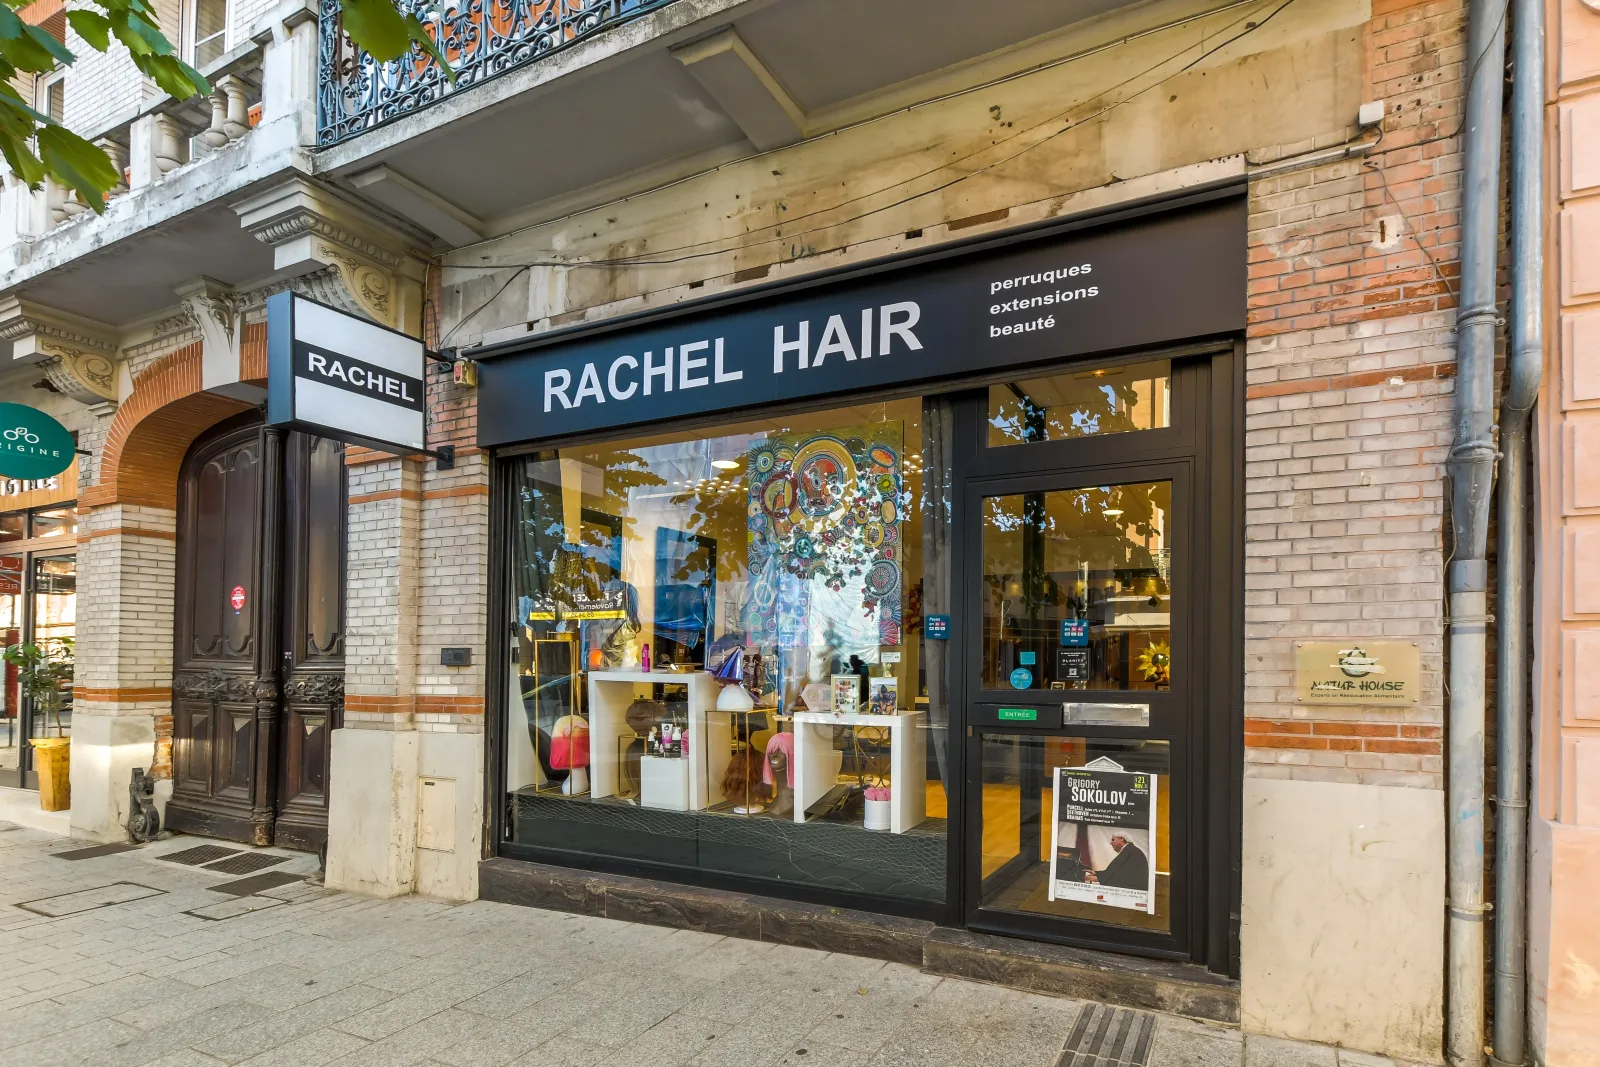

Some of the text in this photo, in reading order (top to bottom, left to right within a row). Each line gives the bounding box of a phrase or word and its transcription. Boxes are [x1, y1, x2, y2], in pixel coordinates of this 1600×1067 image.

[990, 263, 1092, 295] perruques
[990, 286, 1099, 315] extensions
[990, 314, 1056, 338] beauté
[543, 301, 924, 413] RACHEL HAIR
[308, 352, 415, 403] RACHEL
[1359, 680, 1405, 691] HOUSE
[1005, 710, 1031, 718] ENTRÉE
[1067, 777, 1101, 789] GRIGORY
[1071, 786, 1127, 806] SOKOLOV
